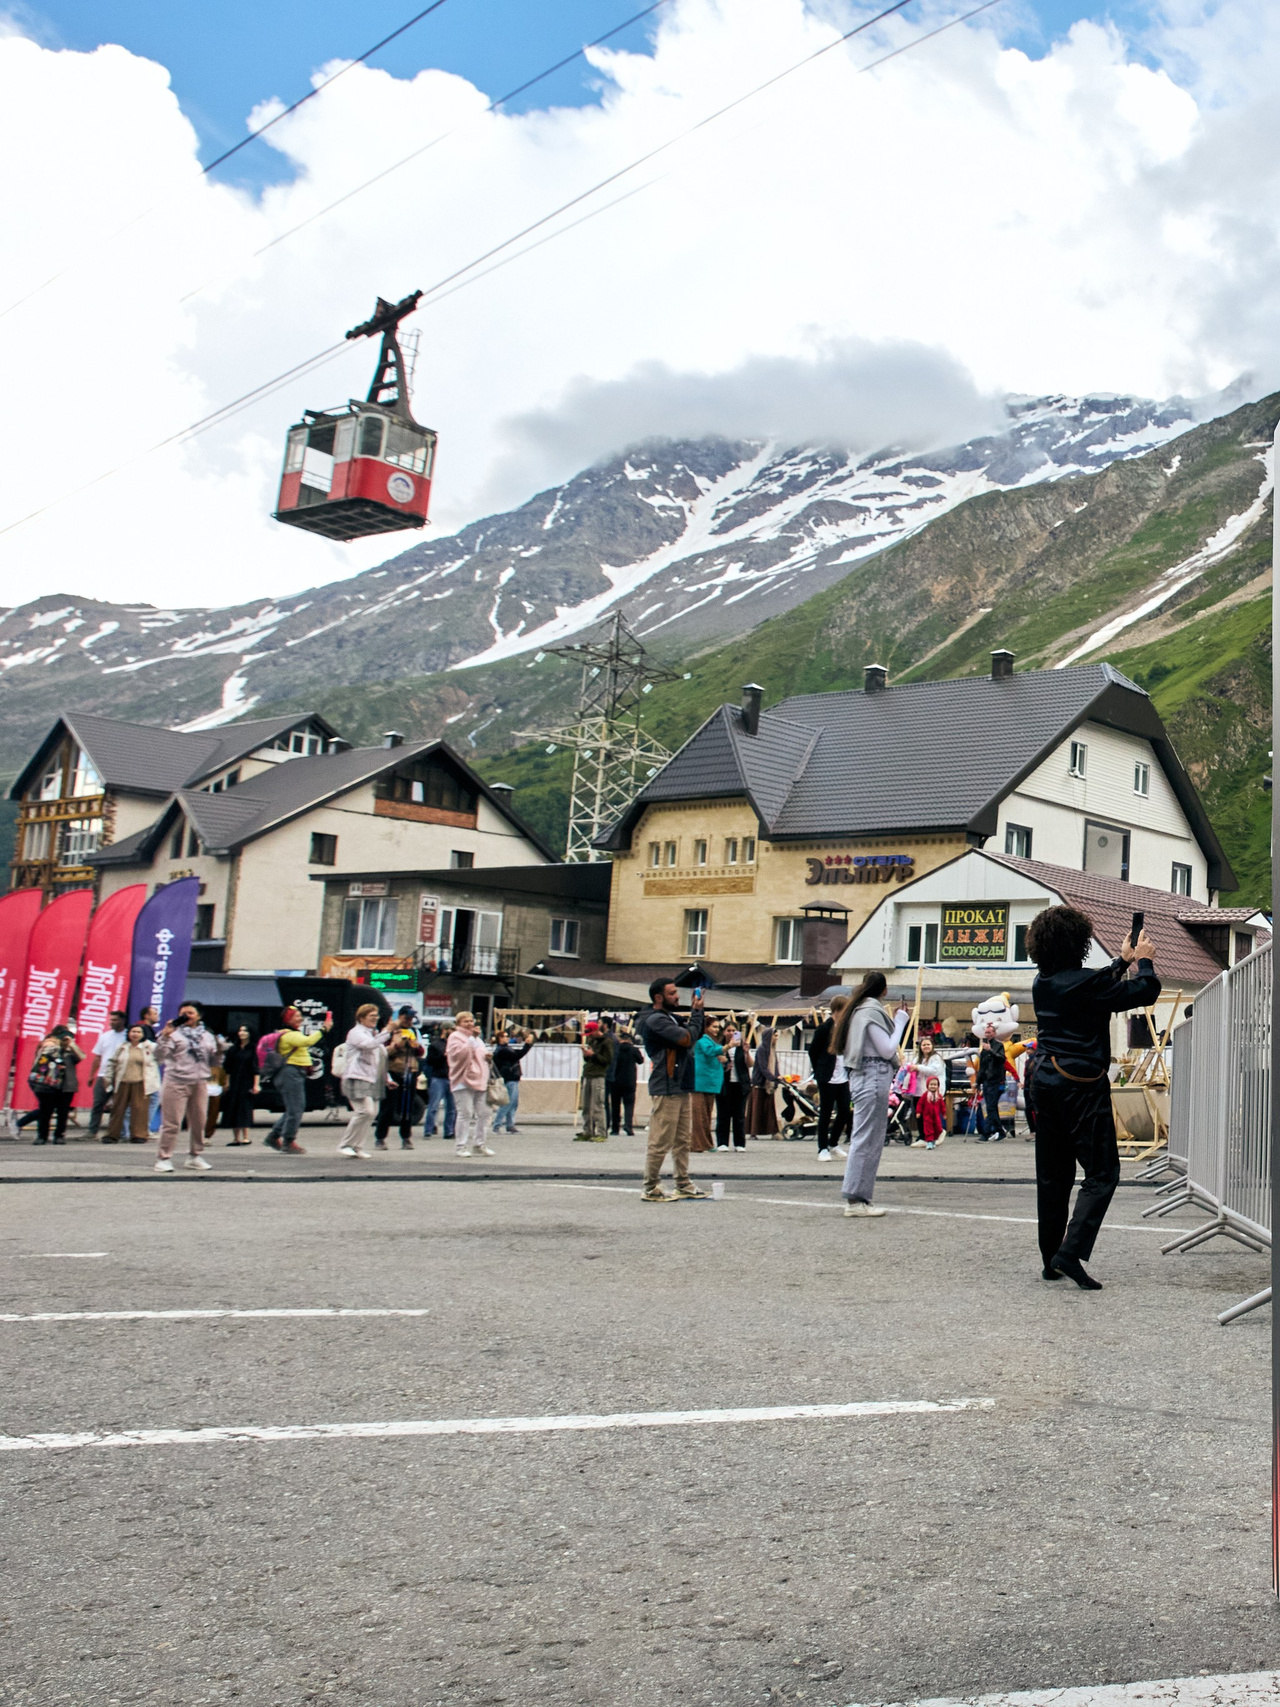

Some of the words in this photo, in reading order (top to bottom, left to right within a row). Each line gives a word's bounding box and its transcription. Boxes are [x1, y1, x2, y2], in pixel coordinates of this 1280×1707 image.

[945, 909, 1005, 924] ПРОКАТ
[943, 929, 1004, 943] ЛЫЖИ
[942, 946, 1005, 957] СНОУБОРДЫ
[151, 928, 175, 1027] авказ.рф
